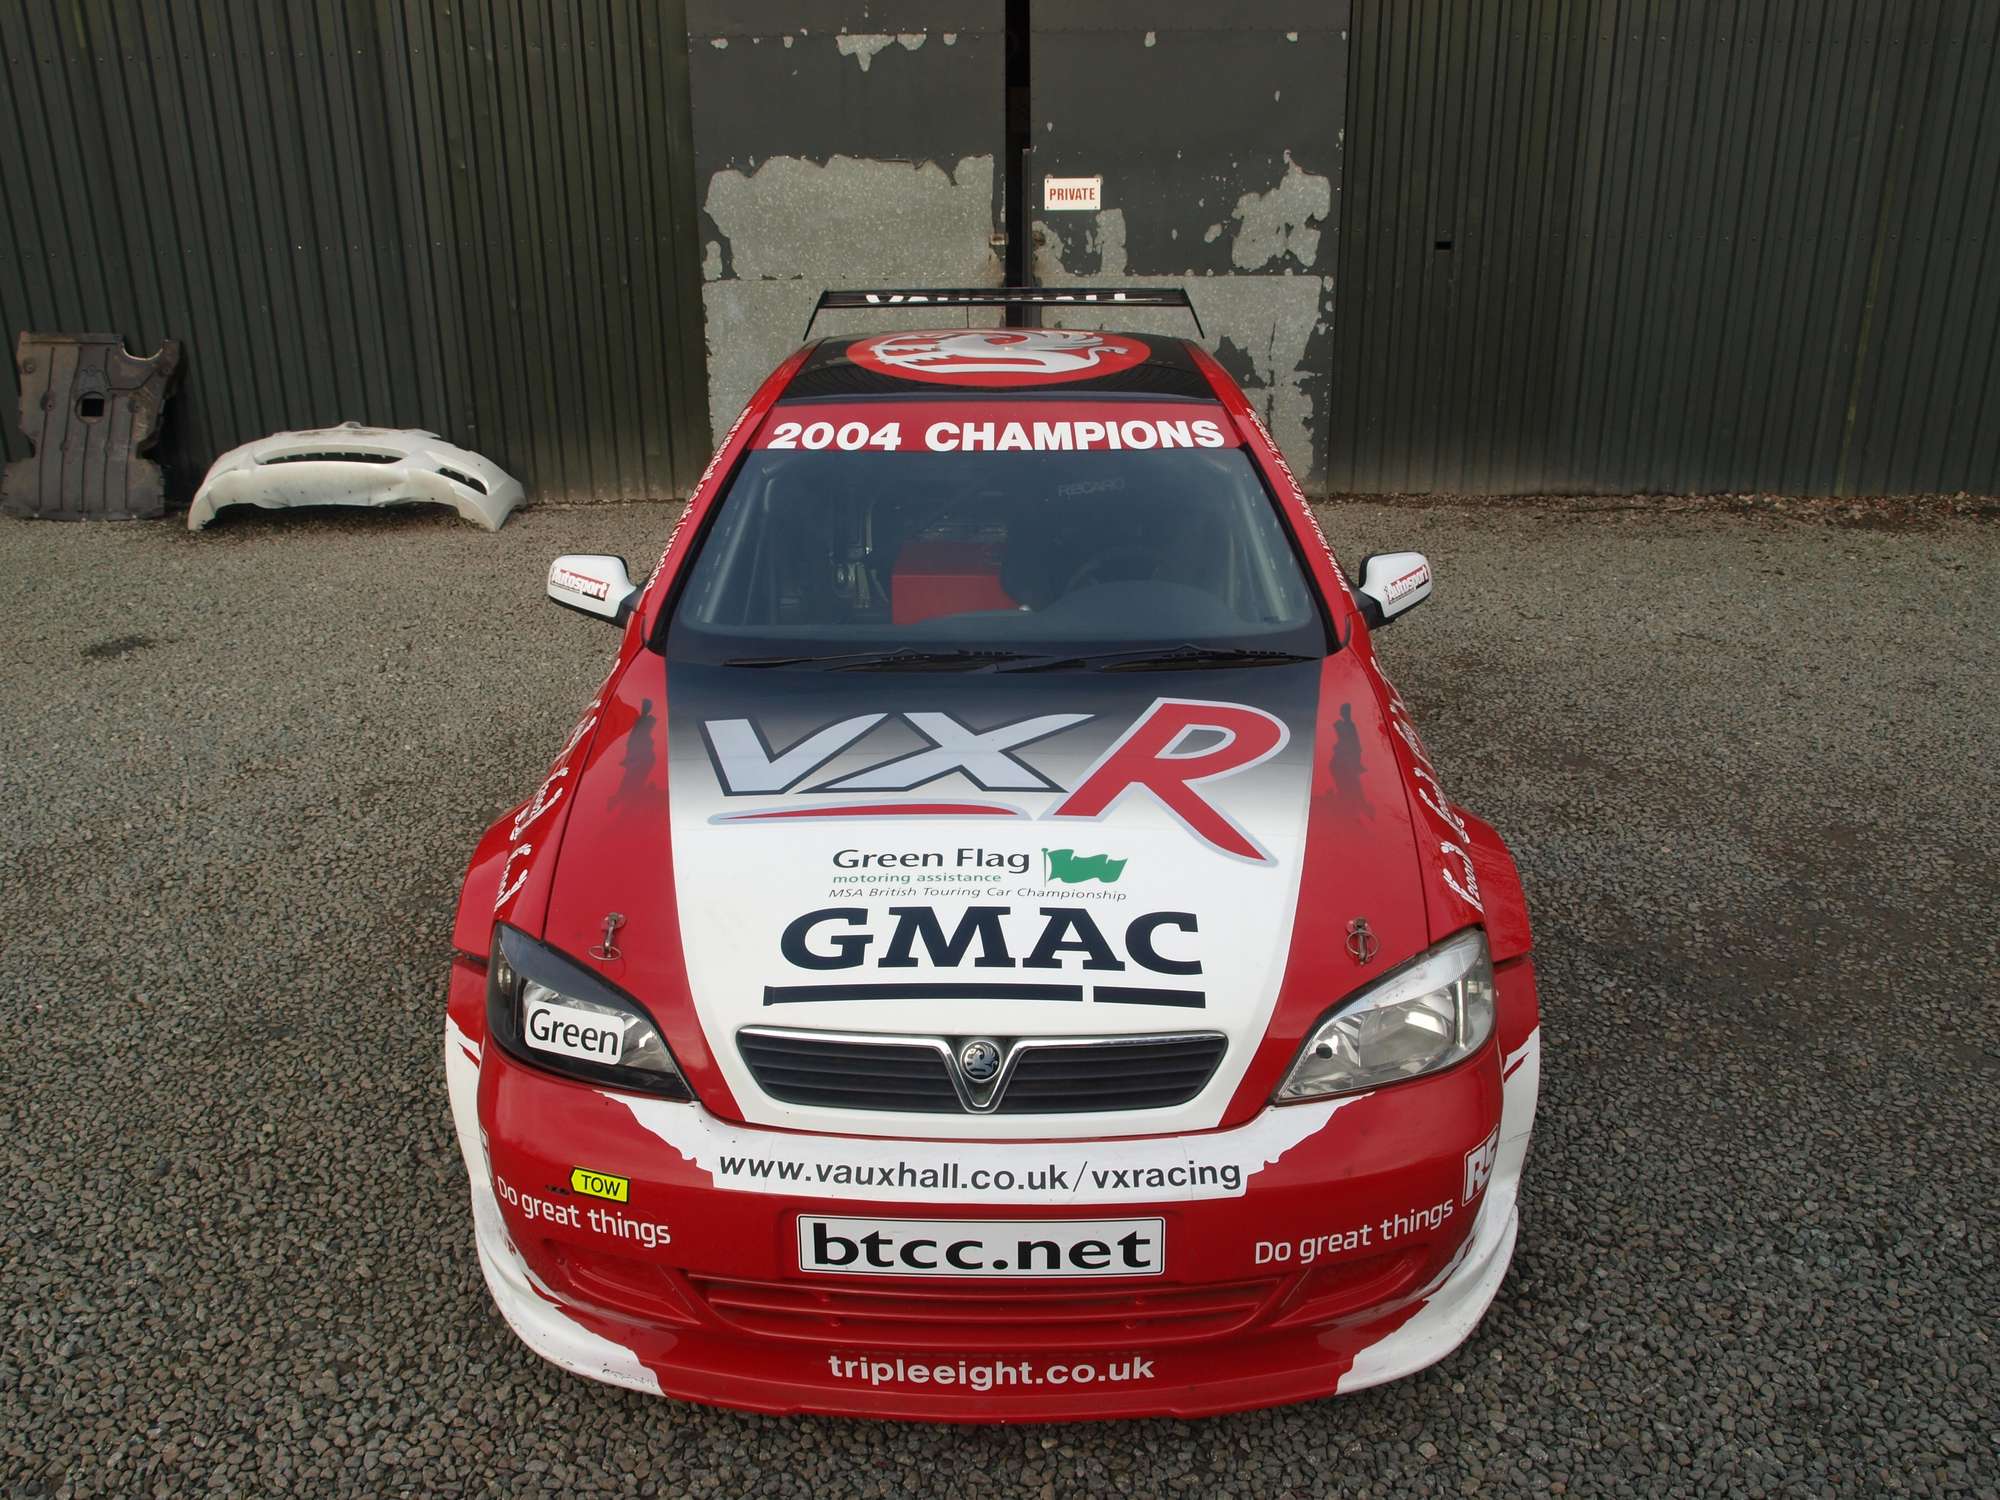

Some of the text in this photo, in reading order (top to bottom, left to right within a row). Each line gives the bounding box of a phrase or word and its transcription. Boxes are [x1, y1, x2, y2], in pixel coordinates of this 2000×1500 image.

[1049, 187, 1096, 202] PRIVATE
[767, 420, 1225, 451] 2004 CHAMPIONS
[700, 697, 1291, 868] VXR
[832, 848, 1030, 874] Green Flag
[832, 873, 1002, 884] motoring assistance
[829, 887, 1127, 902] MSA British Touring Car Championship
[780, 906, 1204, 976] GMAC
[530, 1008, 618, 1056] Green
[581, 1174, 620, 1196] TOW
[497, 1175, 671, 1248] Do great things
[813, 1223, 1151, 1270] btcc.net
[1255, 1199, 1454, 1264] Do great things
[828, 1355, 1155, 1391] tripleeight.co.uk
